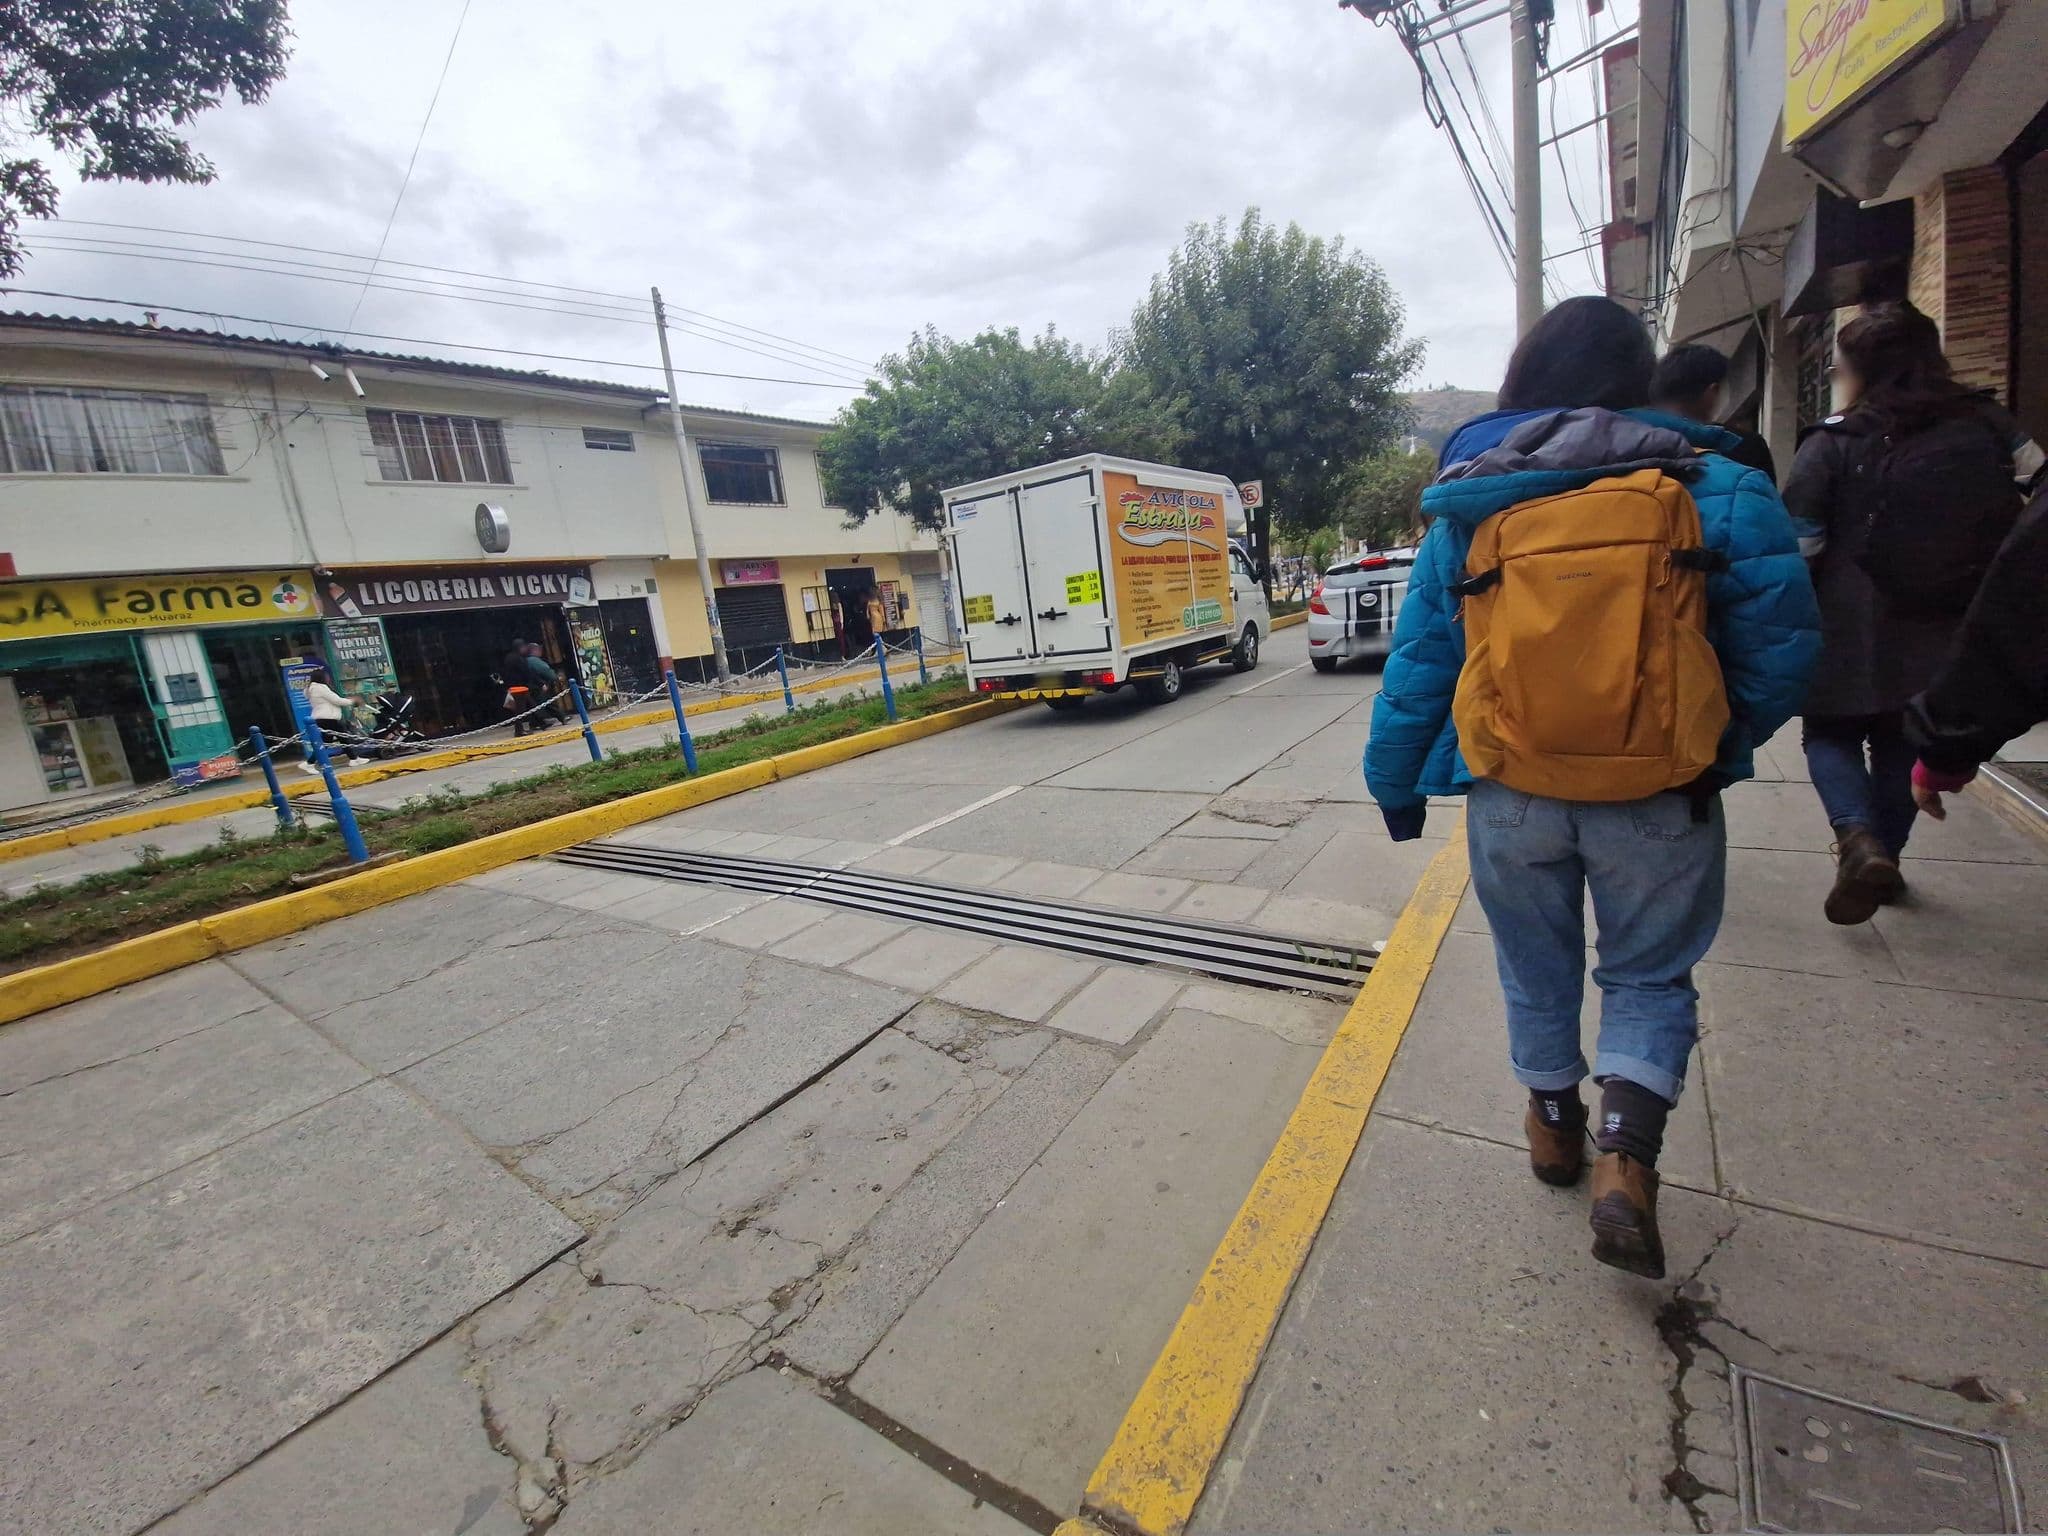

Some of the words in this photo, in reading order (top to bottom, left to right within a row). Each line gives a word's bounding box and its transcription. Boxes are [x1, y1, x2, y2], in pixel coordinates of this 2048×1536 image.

[358, 578, 496, 607] LICORERIA
[498, 573, 569, 597] VICKY
[92, 582, 262, 616] Farma
[73, 616, 137, 629] Pharmacy
[150, 612, 193, 622] Huaraz
[333, 636, 367, 649] VENTA
[368, 635, 381, 646] DE
[340, 646, 382, 661] LICORES
